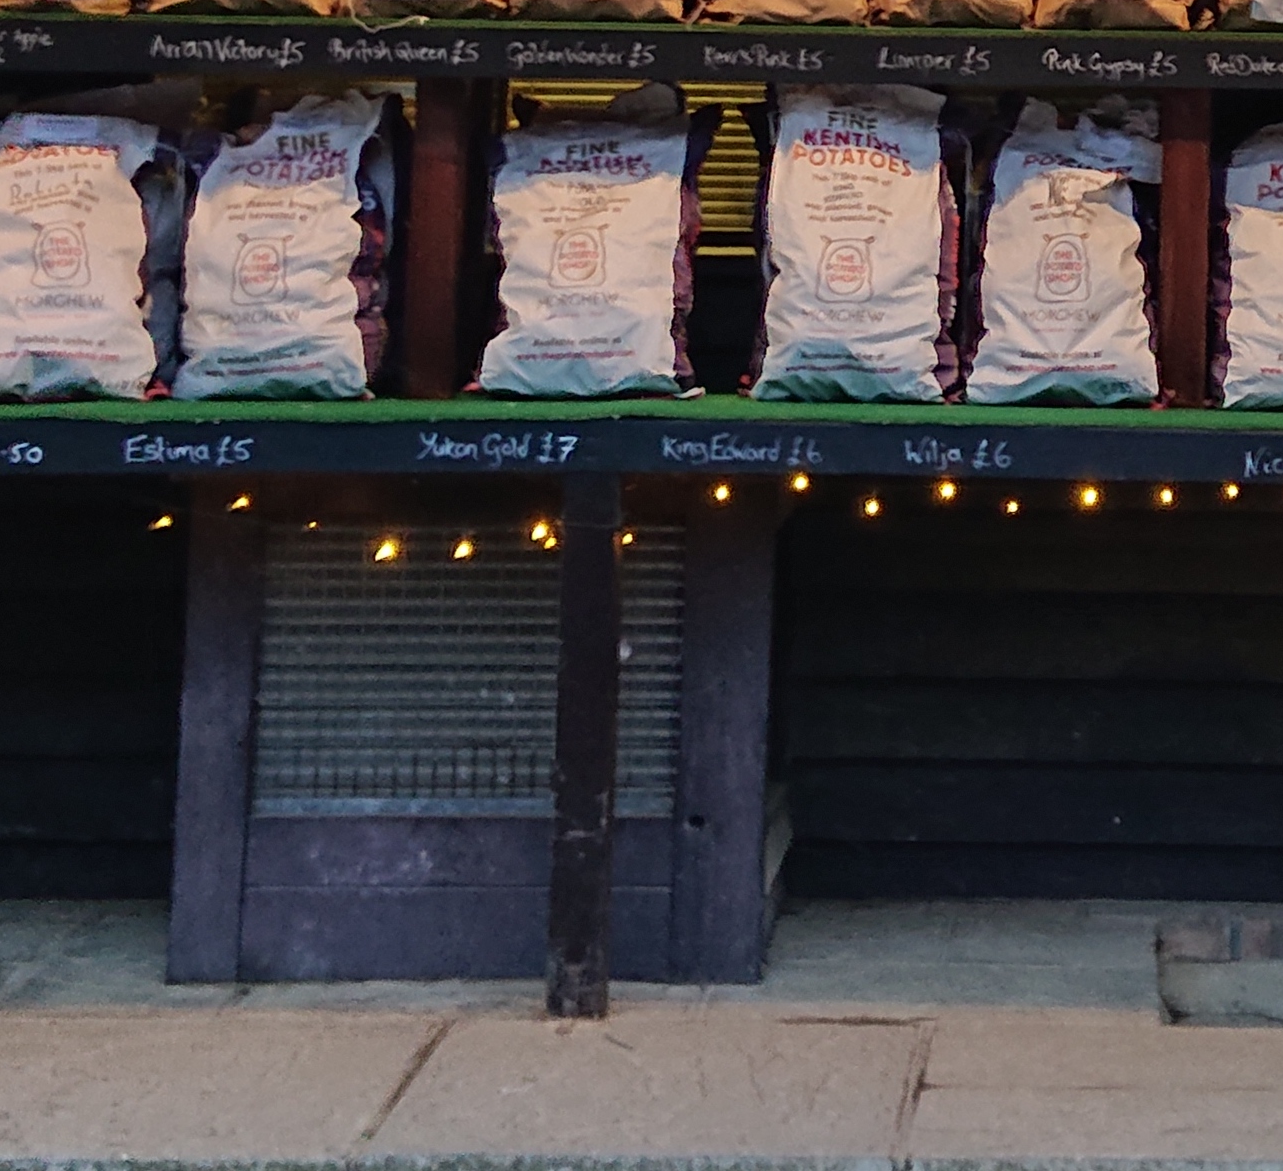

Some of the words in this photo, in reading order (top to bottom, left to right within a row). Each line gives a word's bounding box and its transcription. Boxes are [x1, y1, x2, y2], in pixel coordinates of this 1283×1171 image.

[148, 33, 214, 61] Arran
[274, 36, 307, 69] £5
[327, 37, 394, 64] British
[394, 39, 449, 66] Queen
[449, 38, 481, 67] £5
[626, 40, 659, 69] £5
[958, 44, 993, 77] £5
[1040, 46, 1088, 76] Pink
[1146, 49, 1179, 79] £5
[275, 131, 332, 155] FINE
[565, 139, 621, 161] FINE
[802, 127, 902, 155] KENTISH
[792, 142, 913, 178] POTATOES
[122, 431, 211, 465] Estima
[215, 432, 256, 467] £5
[415, 430, 480, 463] Yukon
[480, 431, 532, 471] Gold
[534, 431, 581, 466] £7
[659, 434, 711, 468] King
[708, 430, 780, 465] Edward
[784, 434, 824, 467] £6
[903, 434, 964, 471] Wilja
[970, 436, 1013, 471] £6
